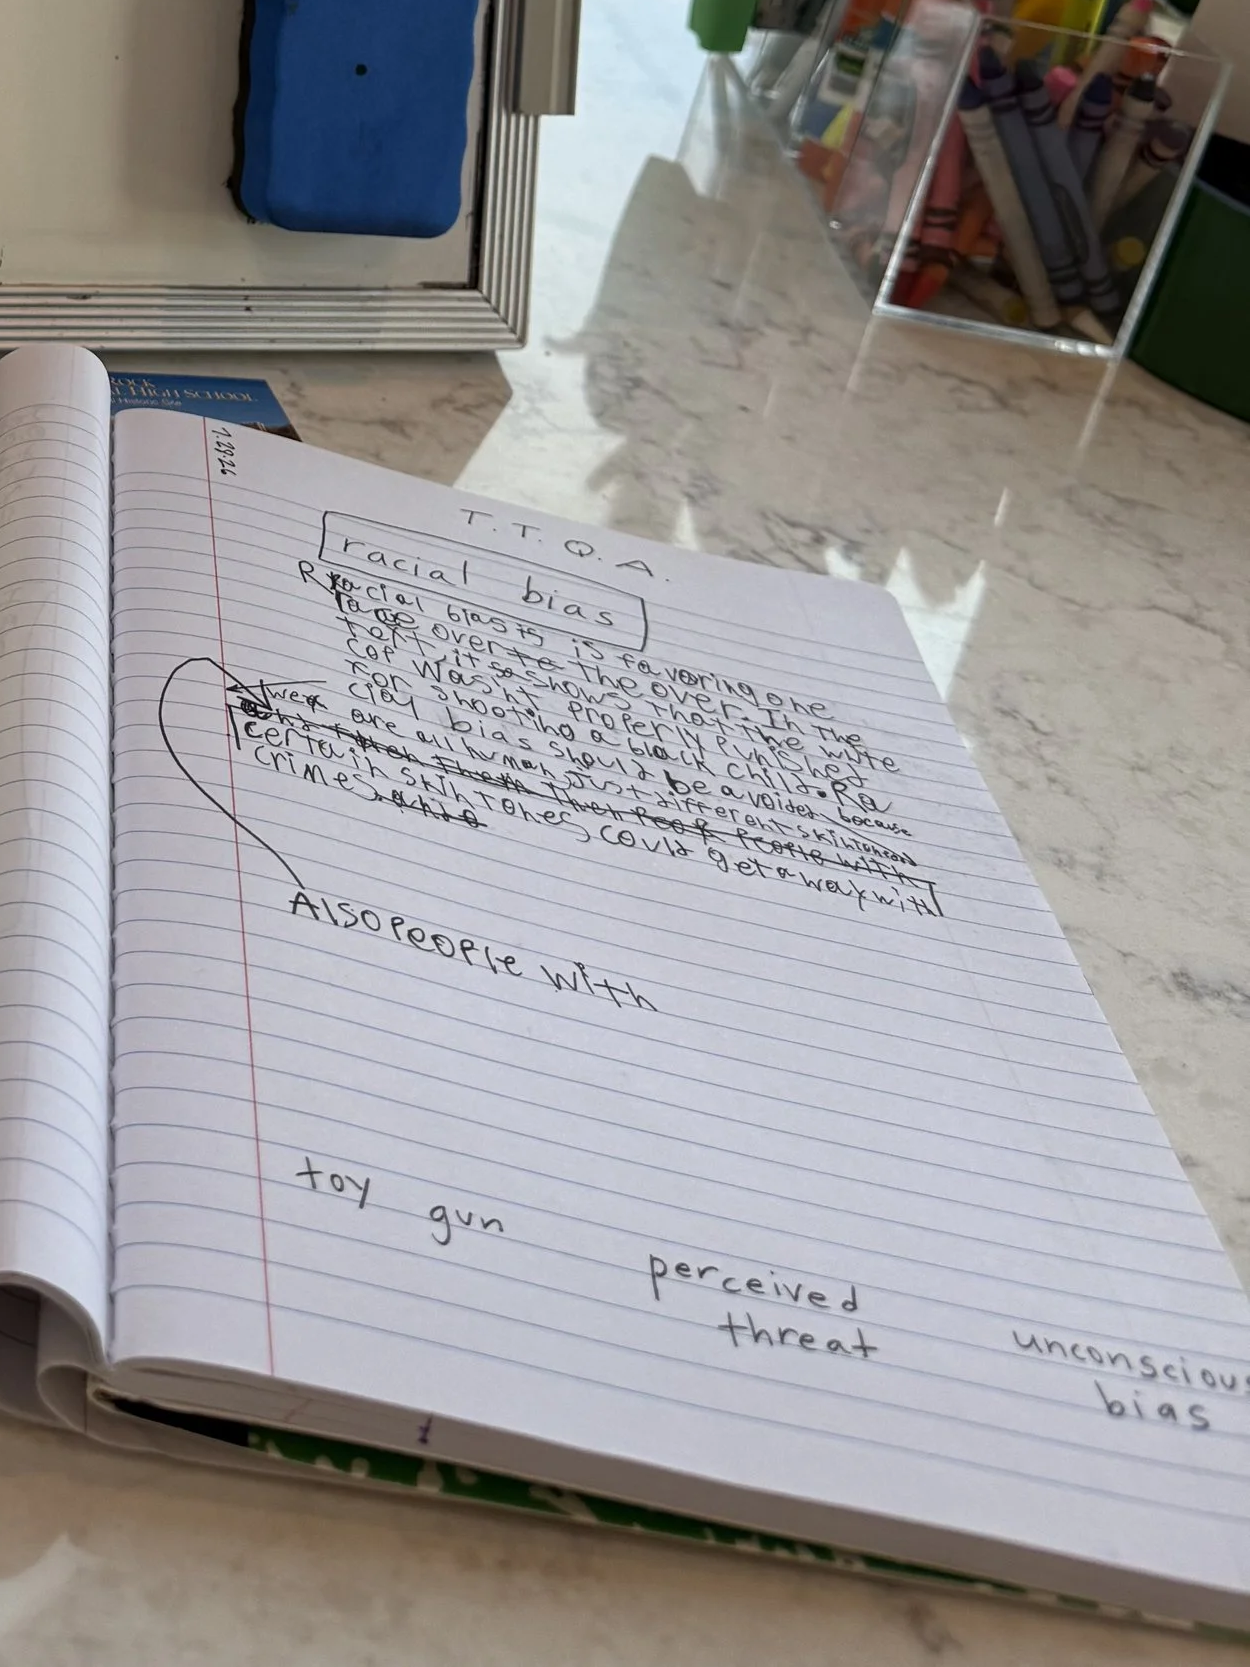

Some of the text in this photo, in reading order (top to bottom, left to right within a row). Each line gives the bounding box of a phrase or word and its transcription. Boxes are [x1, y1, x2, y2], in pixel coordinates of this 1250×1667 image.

[342, 535, 615, 627] racial bias
[446, 603, 508, 634] bias
[571, 637, 605, 661] is
[766, 692, 835, 721] one
[566, 660, 645, 699] the
[757, 706, 806, 736] In
[810, 723, 862, 746] the
[350, 708, 407, 739] are
[415, 730, 455, 752] all
[445, 705, 533, 751] bias
[662, 768, 712, 796] be
[627, 737, 716, 777] black
[644, 698, 735, 736] that
[734, 723, 805, 751] the
[243, 720, 390, 780] certain
[400, 766, 476, 811] skin
[599, 824, 694, 858] could
[289, 891, 381, 931] Also
[541, 961, 659, 1012] with
[295, 1156, 505, 1246] toy gun
[649, 1253, 859, 1312] perceived
[718, 1311, 878, 1358] threat
[1093, 1378, 1211, 1431] bias
